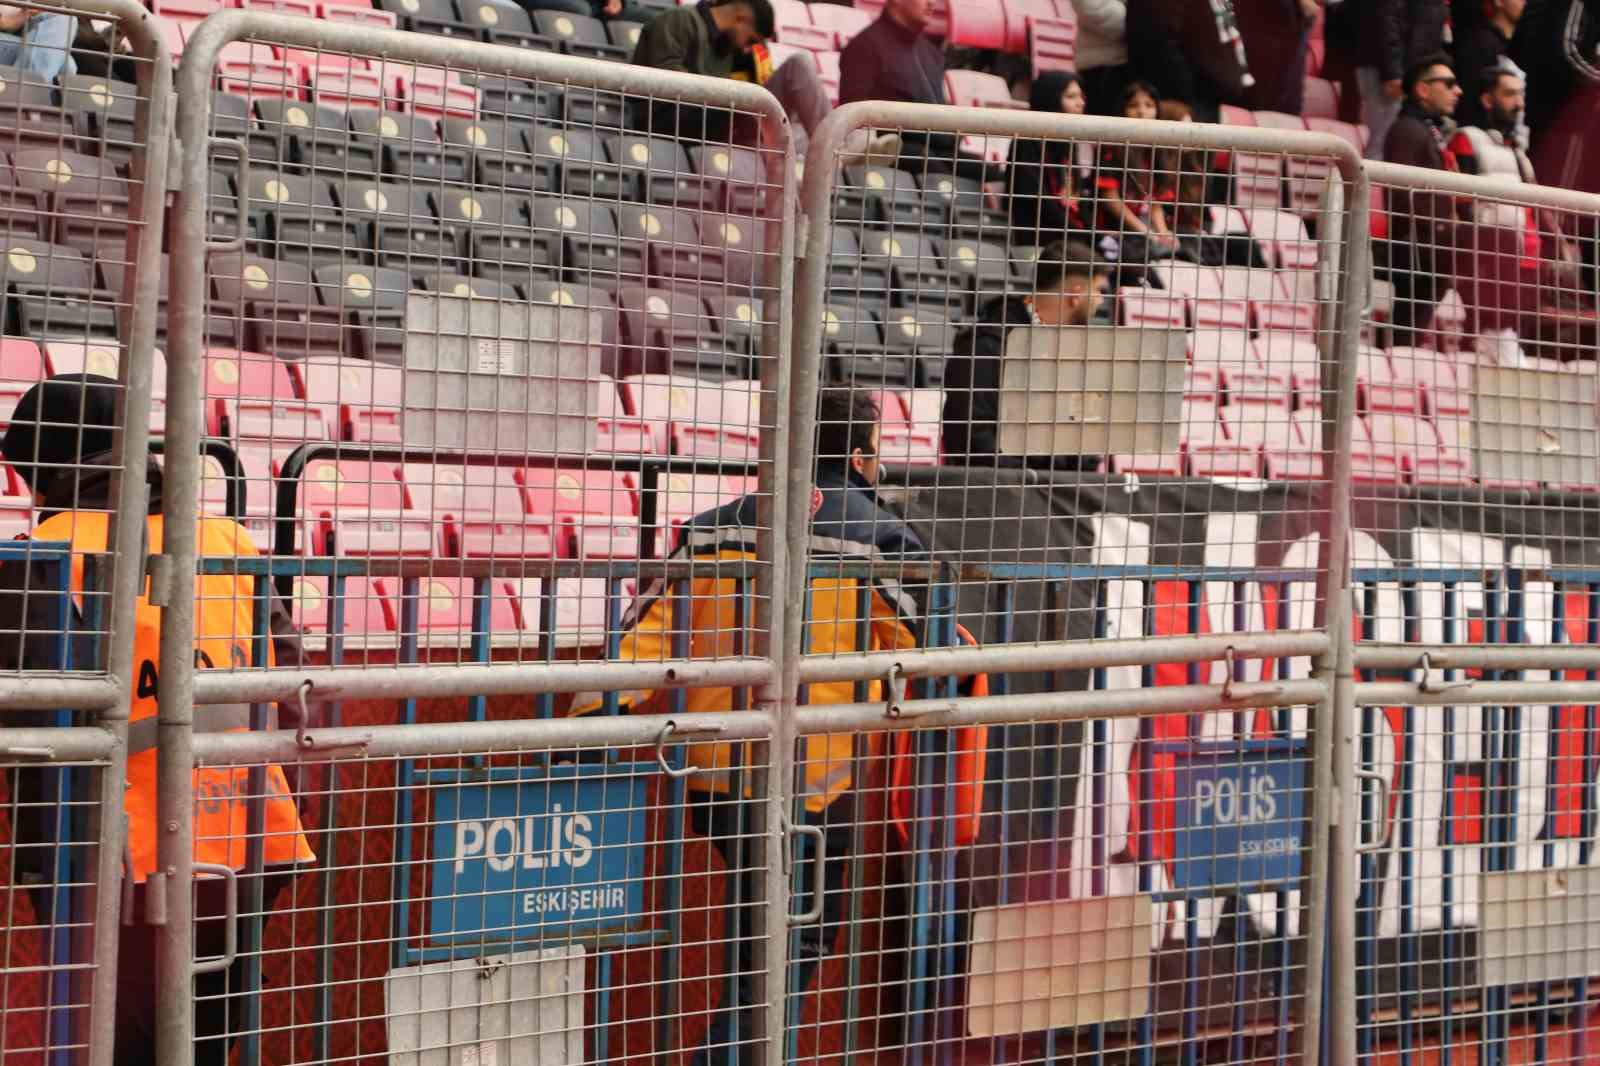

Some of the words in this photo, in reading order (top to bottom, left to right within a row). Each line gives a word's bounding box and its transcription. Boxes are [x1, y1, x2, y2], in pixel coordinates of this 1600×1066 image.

[1195, 766, 1277, 825] POLİS
[454, 803, 593, 874] POLİS
[523, 884, 625, 915] ESKİŞEHİR
